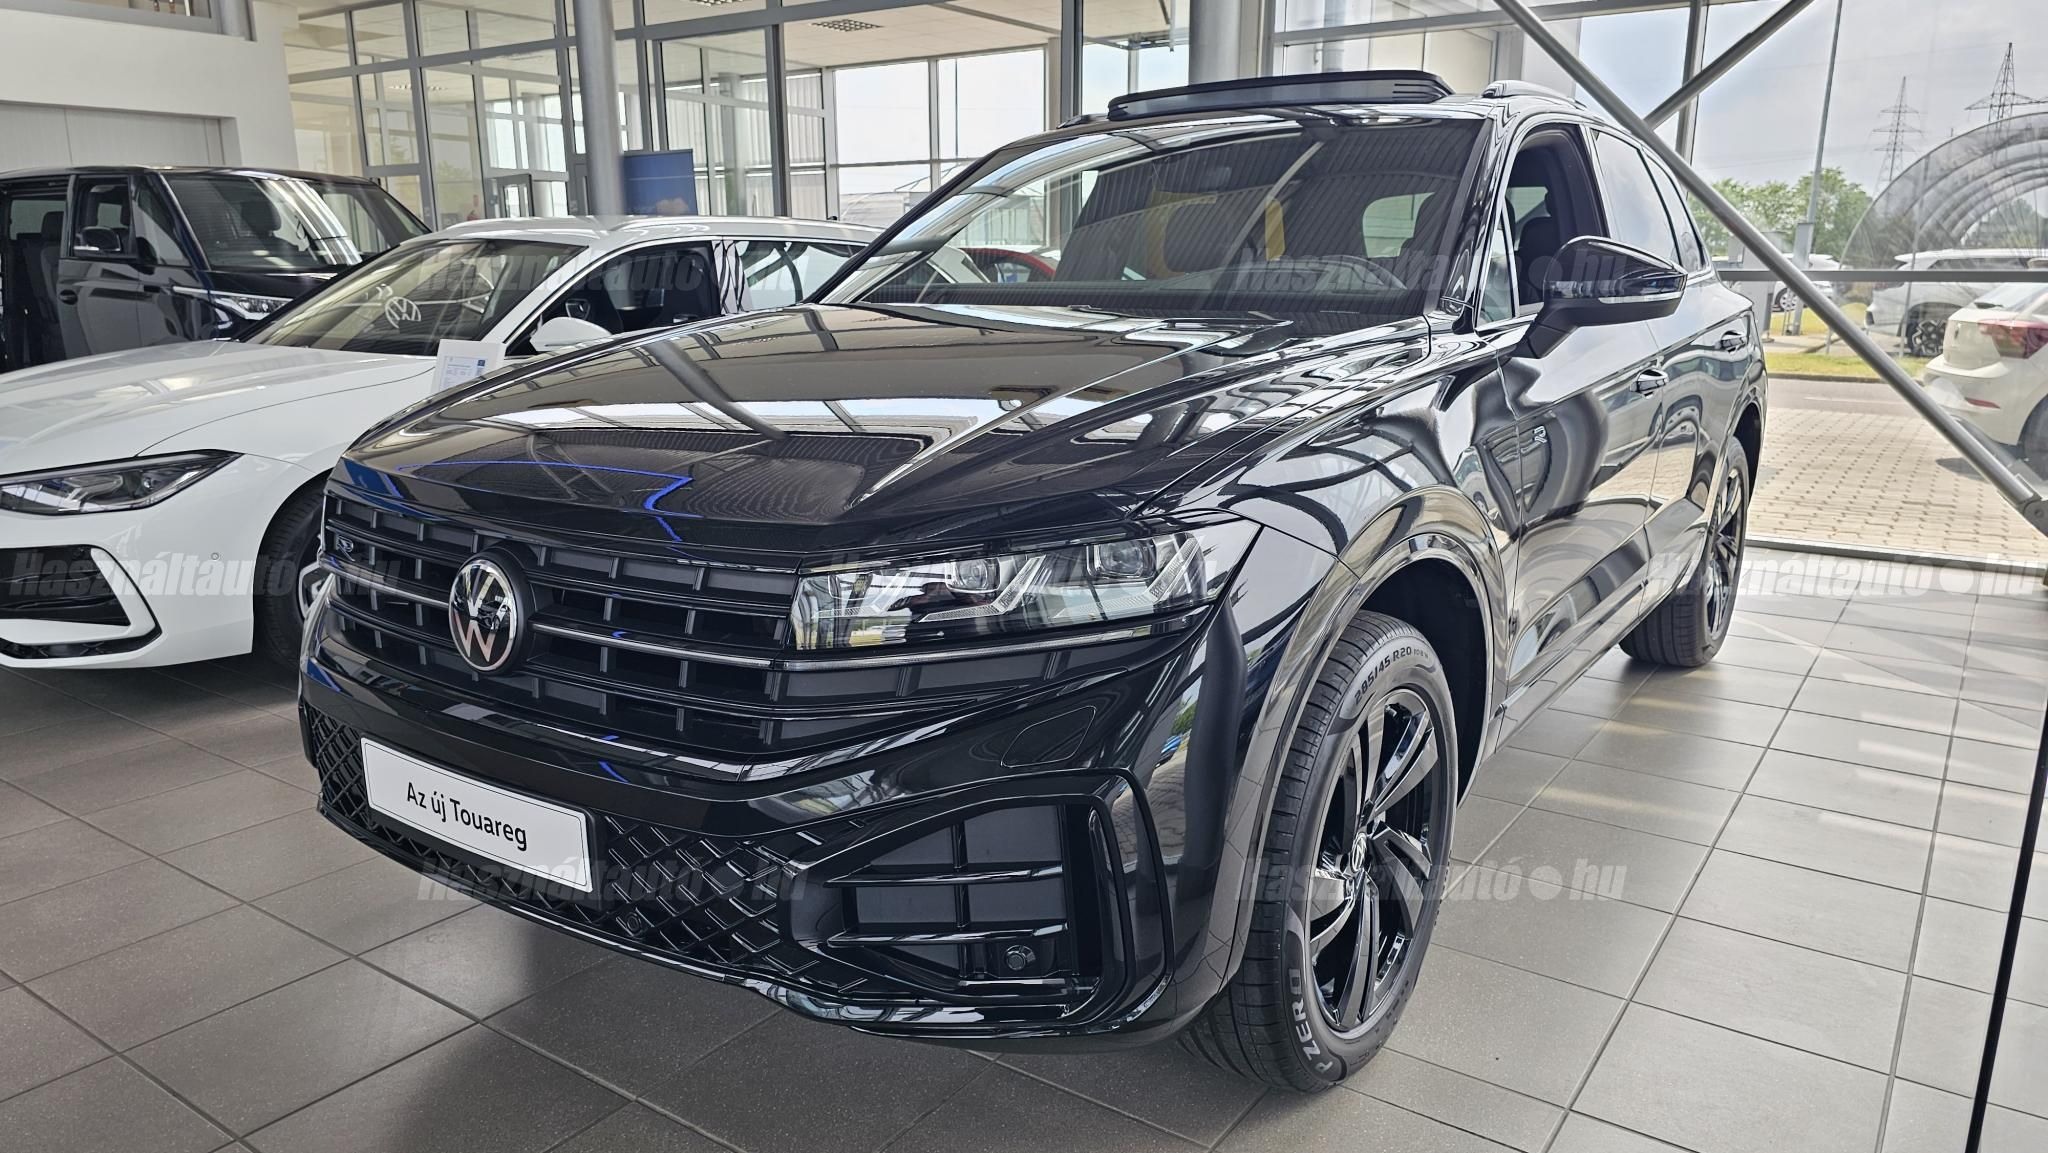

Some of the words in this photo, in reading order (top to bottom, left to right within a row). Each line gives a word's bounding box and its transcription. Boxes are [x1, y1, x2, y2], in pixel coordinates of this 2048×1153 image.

[1354, 655, 1391, 705] 285/45
[1393, 646, 1412, 661] R20
[406, 781, 427, 809] Az
[431, 790, 446, 822] új
[449, 797, 527, 851] Touareg
[1288, 968, 1321, 1061] ZERO
[1315, 1060, 1334, 1073] P
